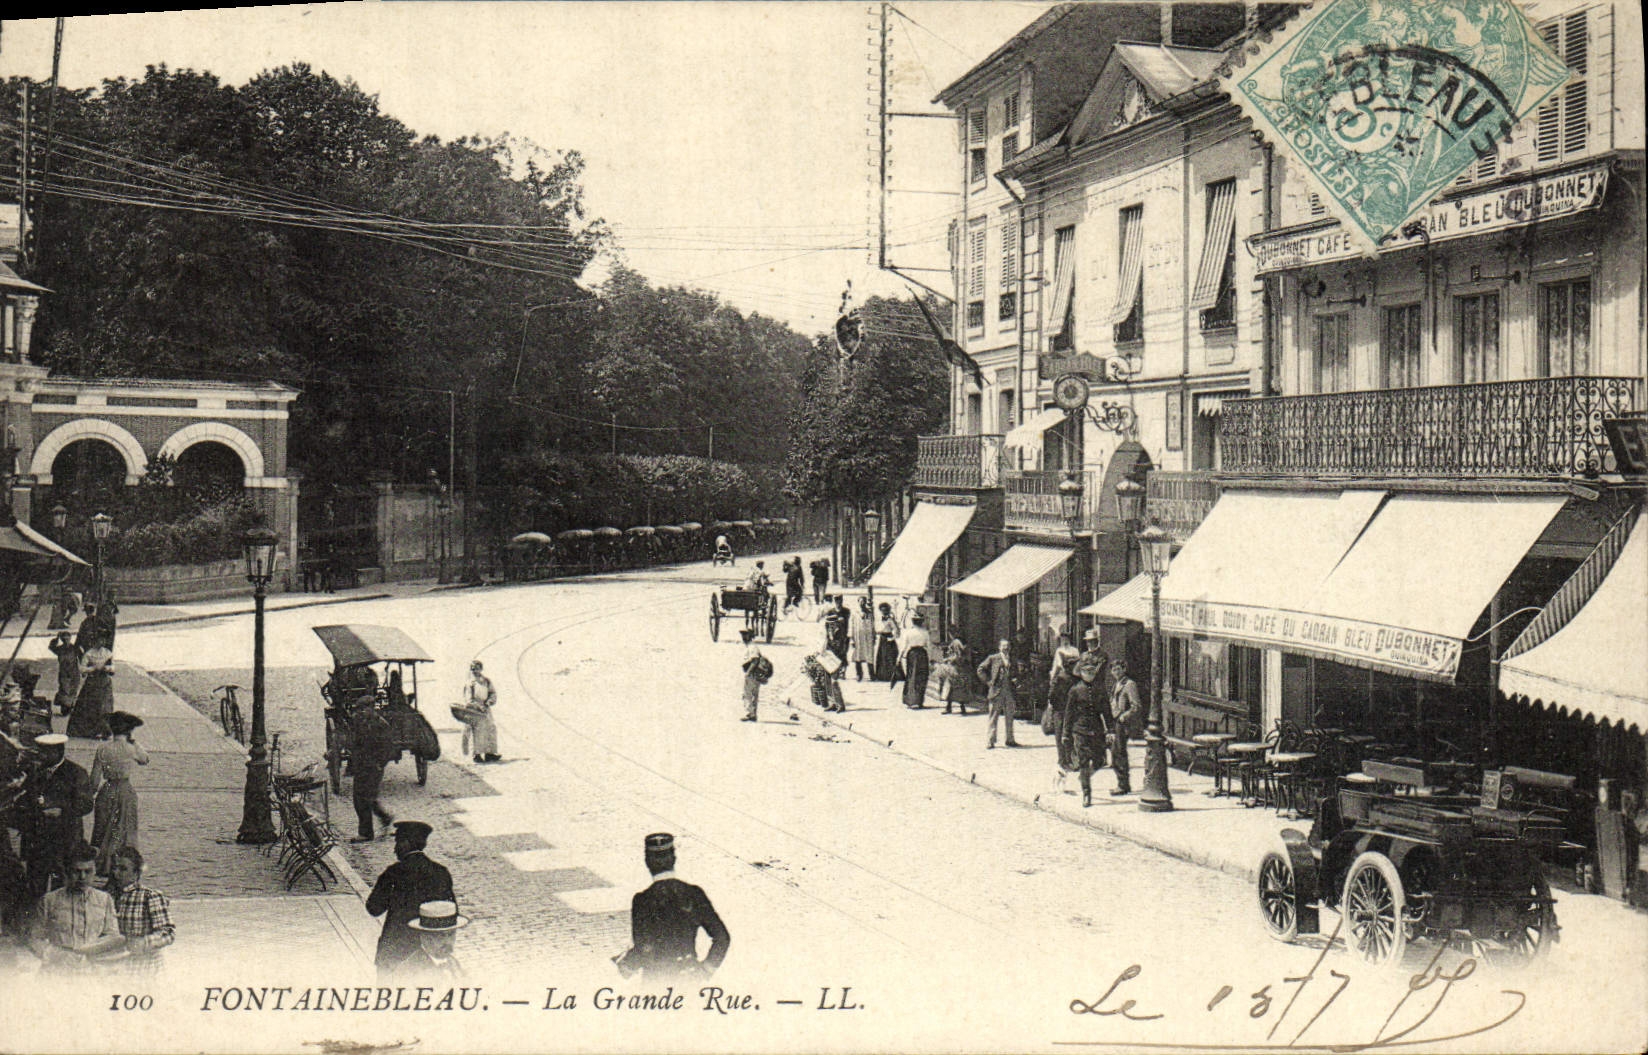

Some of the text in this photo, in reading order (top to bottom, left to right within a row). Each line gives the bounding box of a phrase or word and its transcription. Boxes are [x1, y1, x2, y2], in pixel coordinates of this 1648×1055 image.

[1280, 112, 1354, 194] POSTES
[1459, 194, 1505, 228] BLEU
[1513, 172, 1597, 217] DUBONNET
[1344, 628, 1372, 651] BLEU
[1375, 629, 1449, 661] DUBONNET
[1069, 964, 1164, 1019] Le
